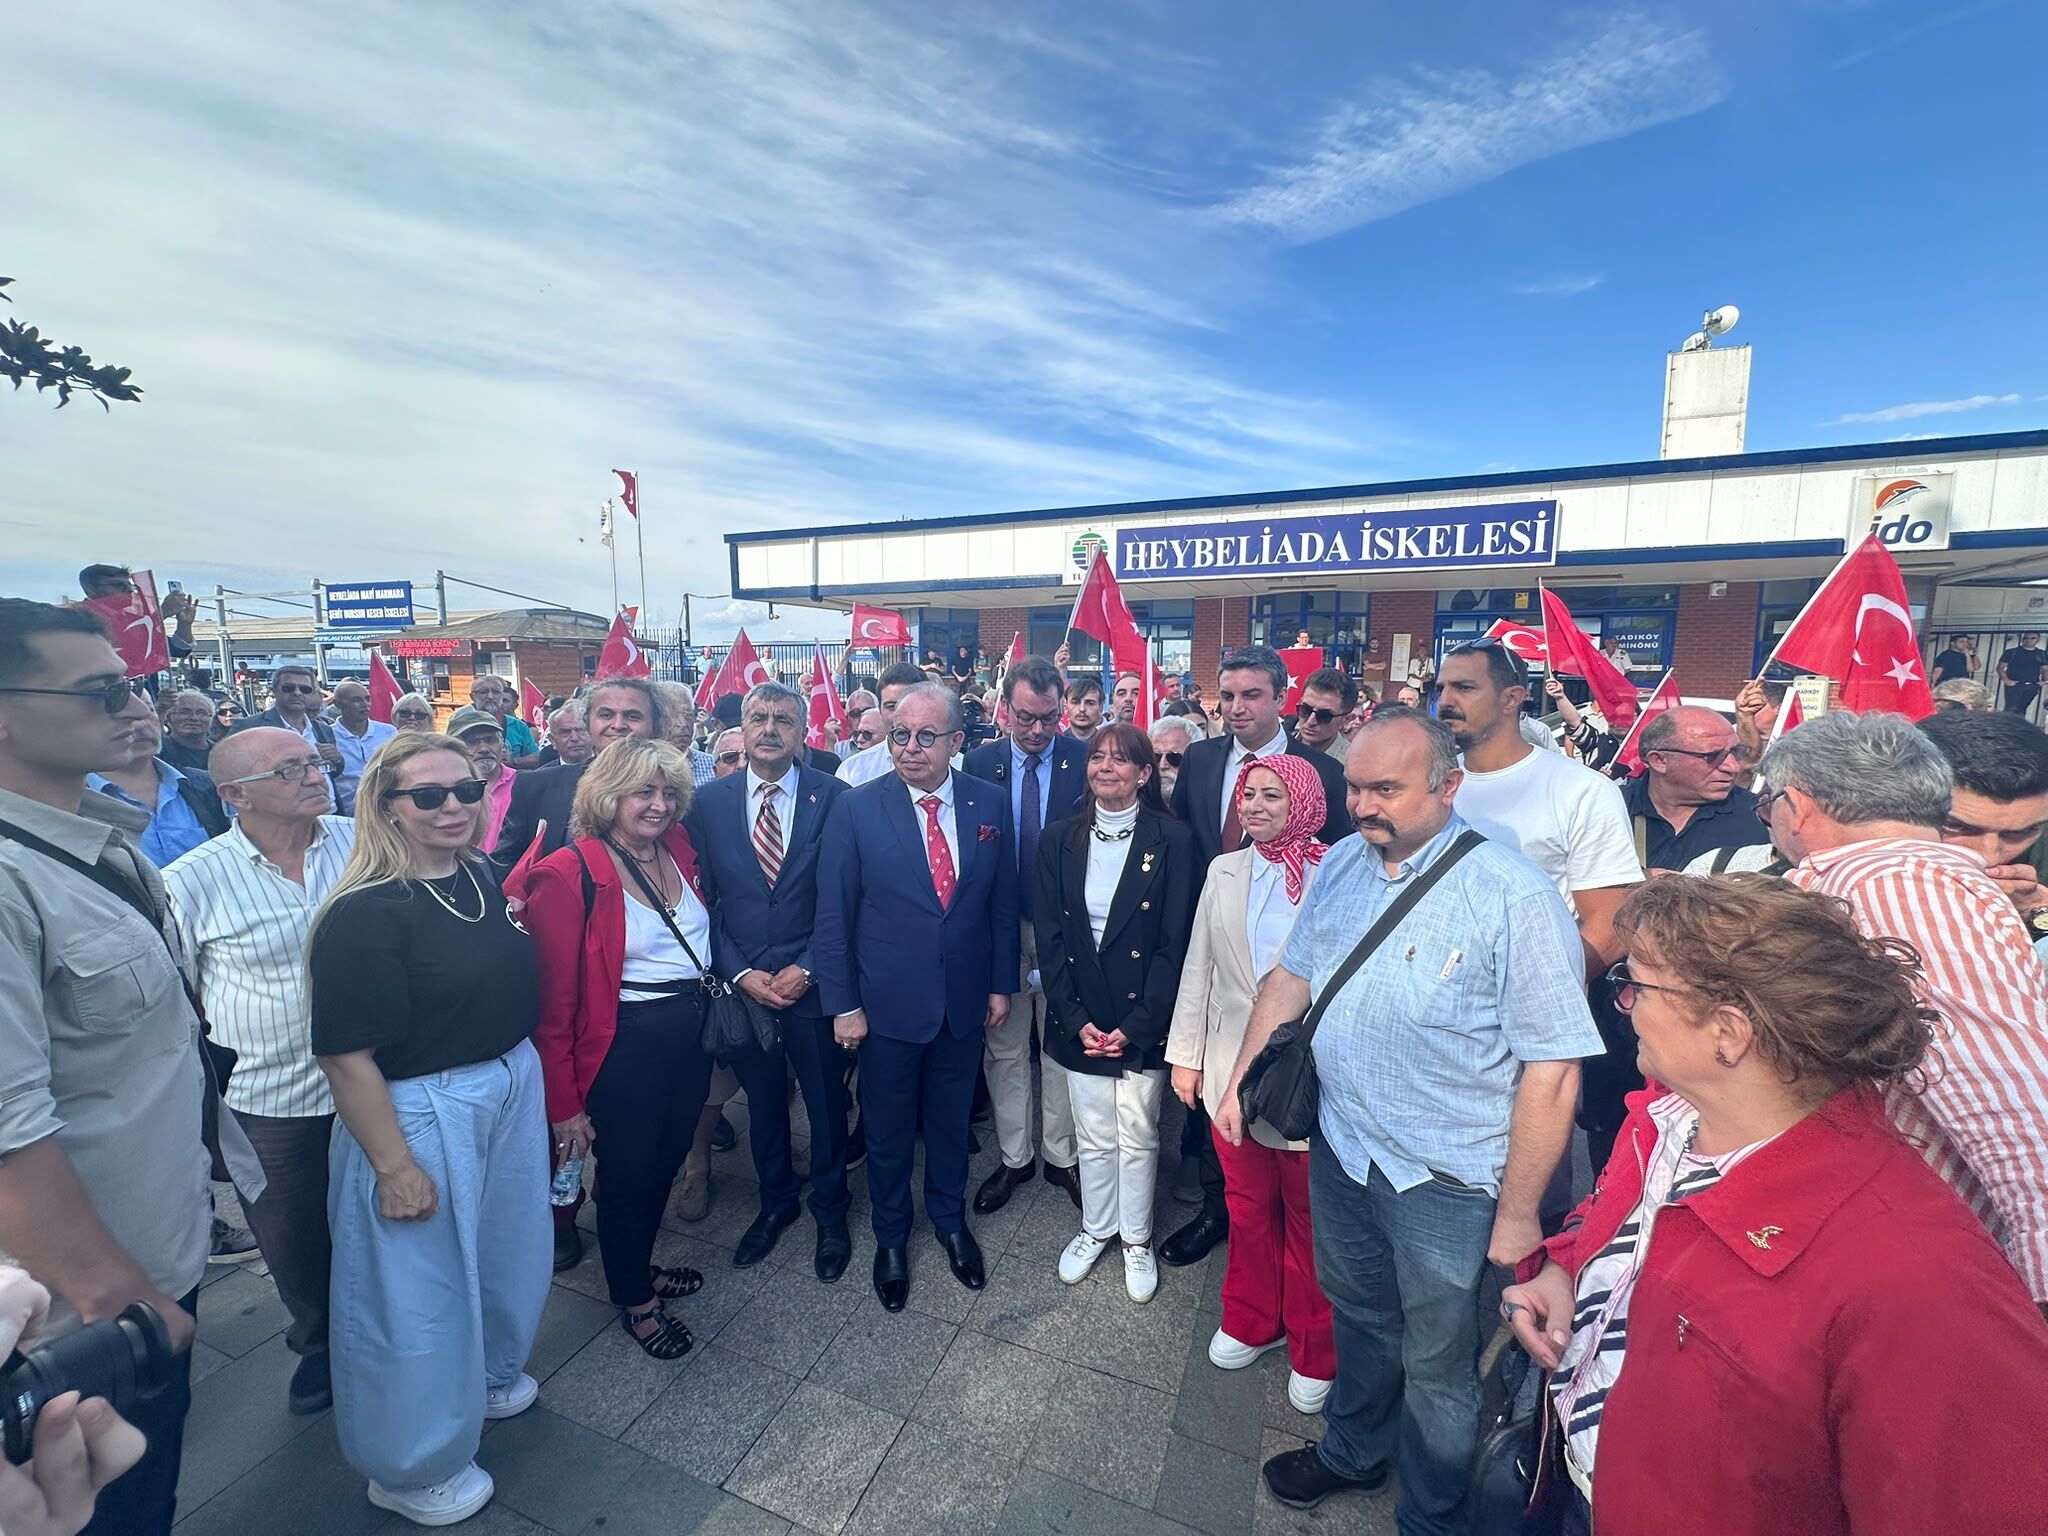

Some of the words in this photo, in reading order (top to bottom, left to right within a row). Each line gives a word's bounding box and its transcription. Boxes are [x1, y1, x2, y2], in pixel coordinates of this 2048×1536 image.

[1123, 526, 1351, 571] HEYBELİADA
[1358, 510, 1550, 561] İSKELESİ
[1869, 514, 1933, 545] ido
[1618, 641, 1659, 649] MİNÖNÜ
